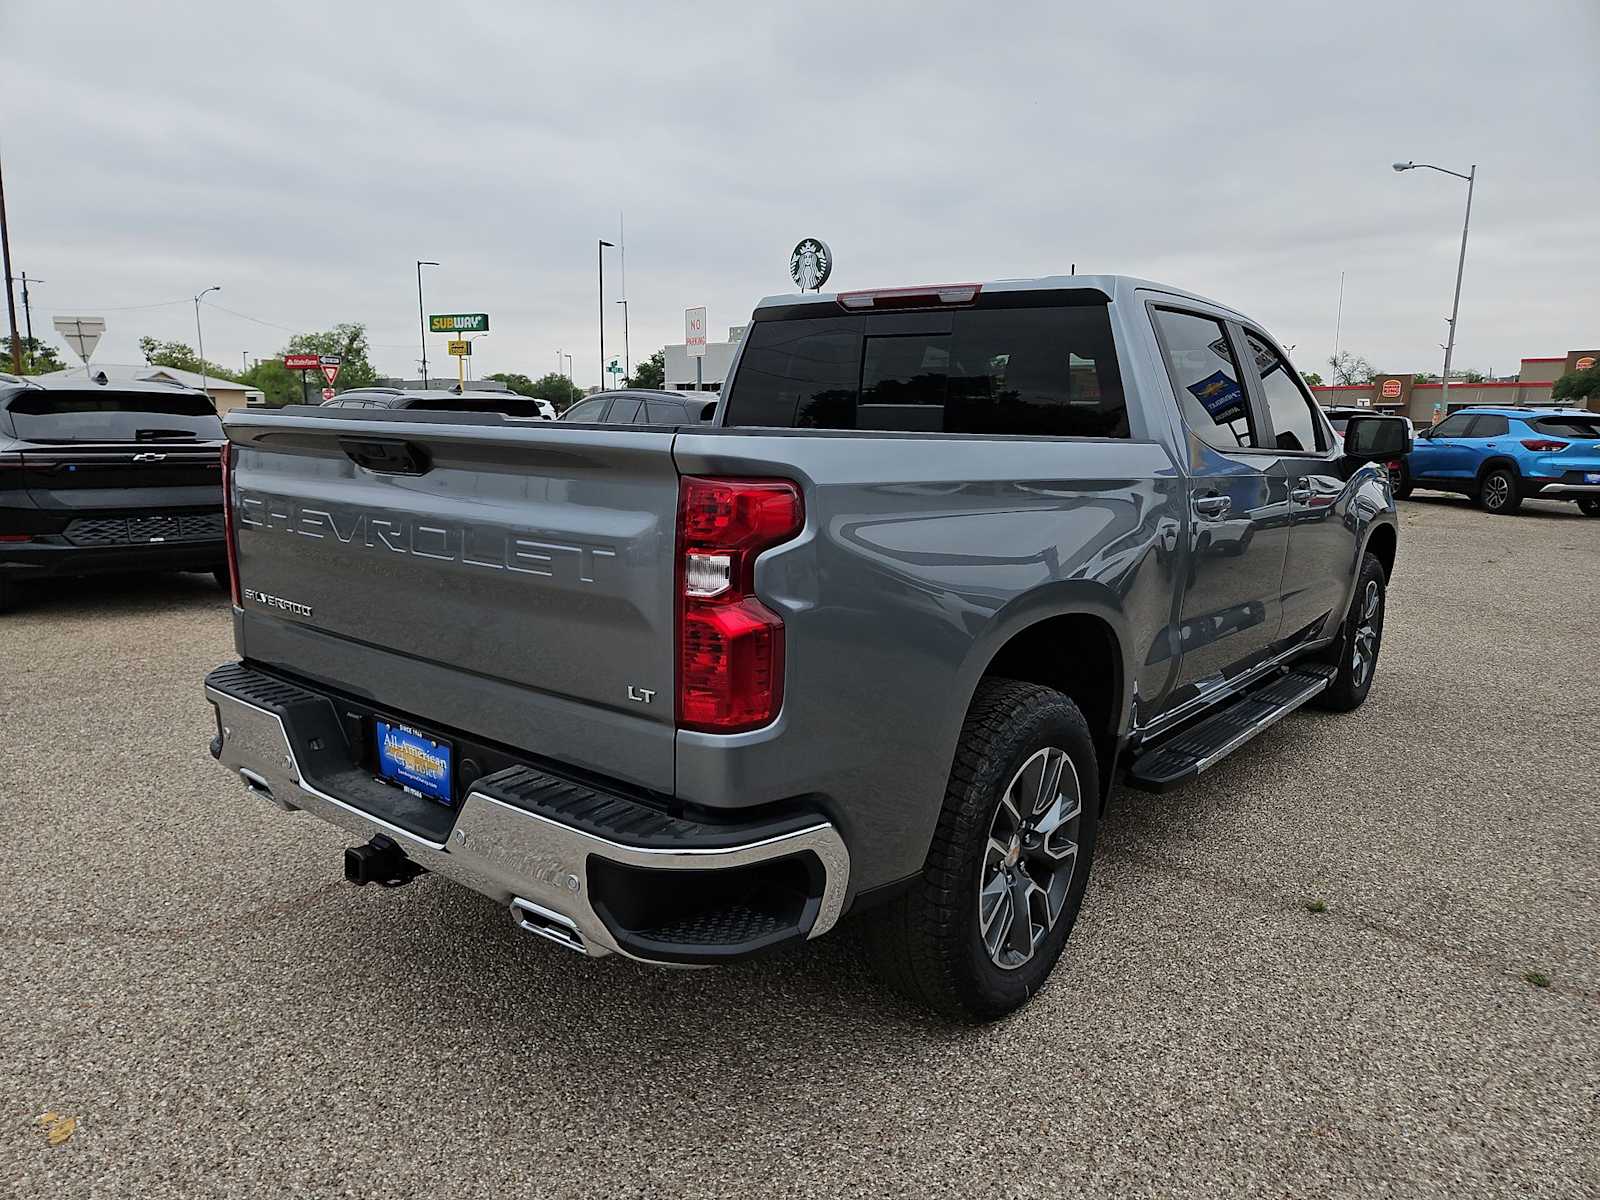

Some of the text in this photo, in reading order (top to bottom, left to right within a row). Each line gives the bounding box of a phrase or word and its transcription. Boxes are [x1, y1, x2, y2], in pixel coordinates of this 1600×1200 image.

[432, 316, 480, 329] SUBWAY
[690, 319, 701, 331] NO
[687, 336, 705, 346] PARKING
[239, 498, 617, 583] CHEVROLET
[244, 588, 312, 617] SILVERADO
[627, 685, 655, 703] LT
[384, 733, 447, 769] All American
